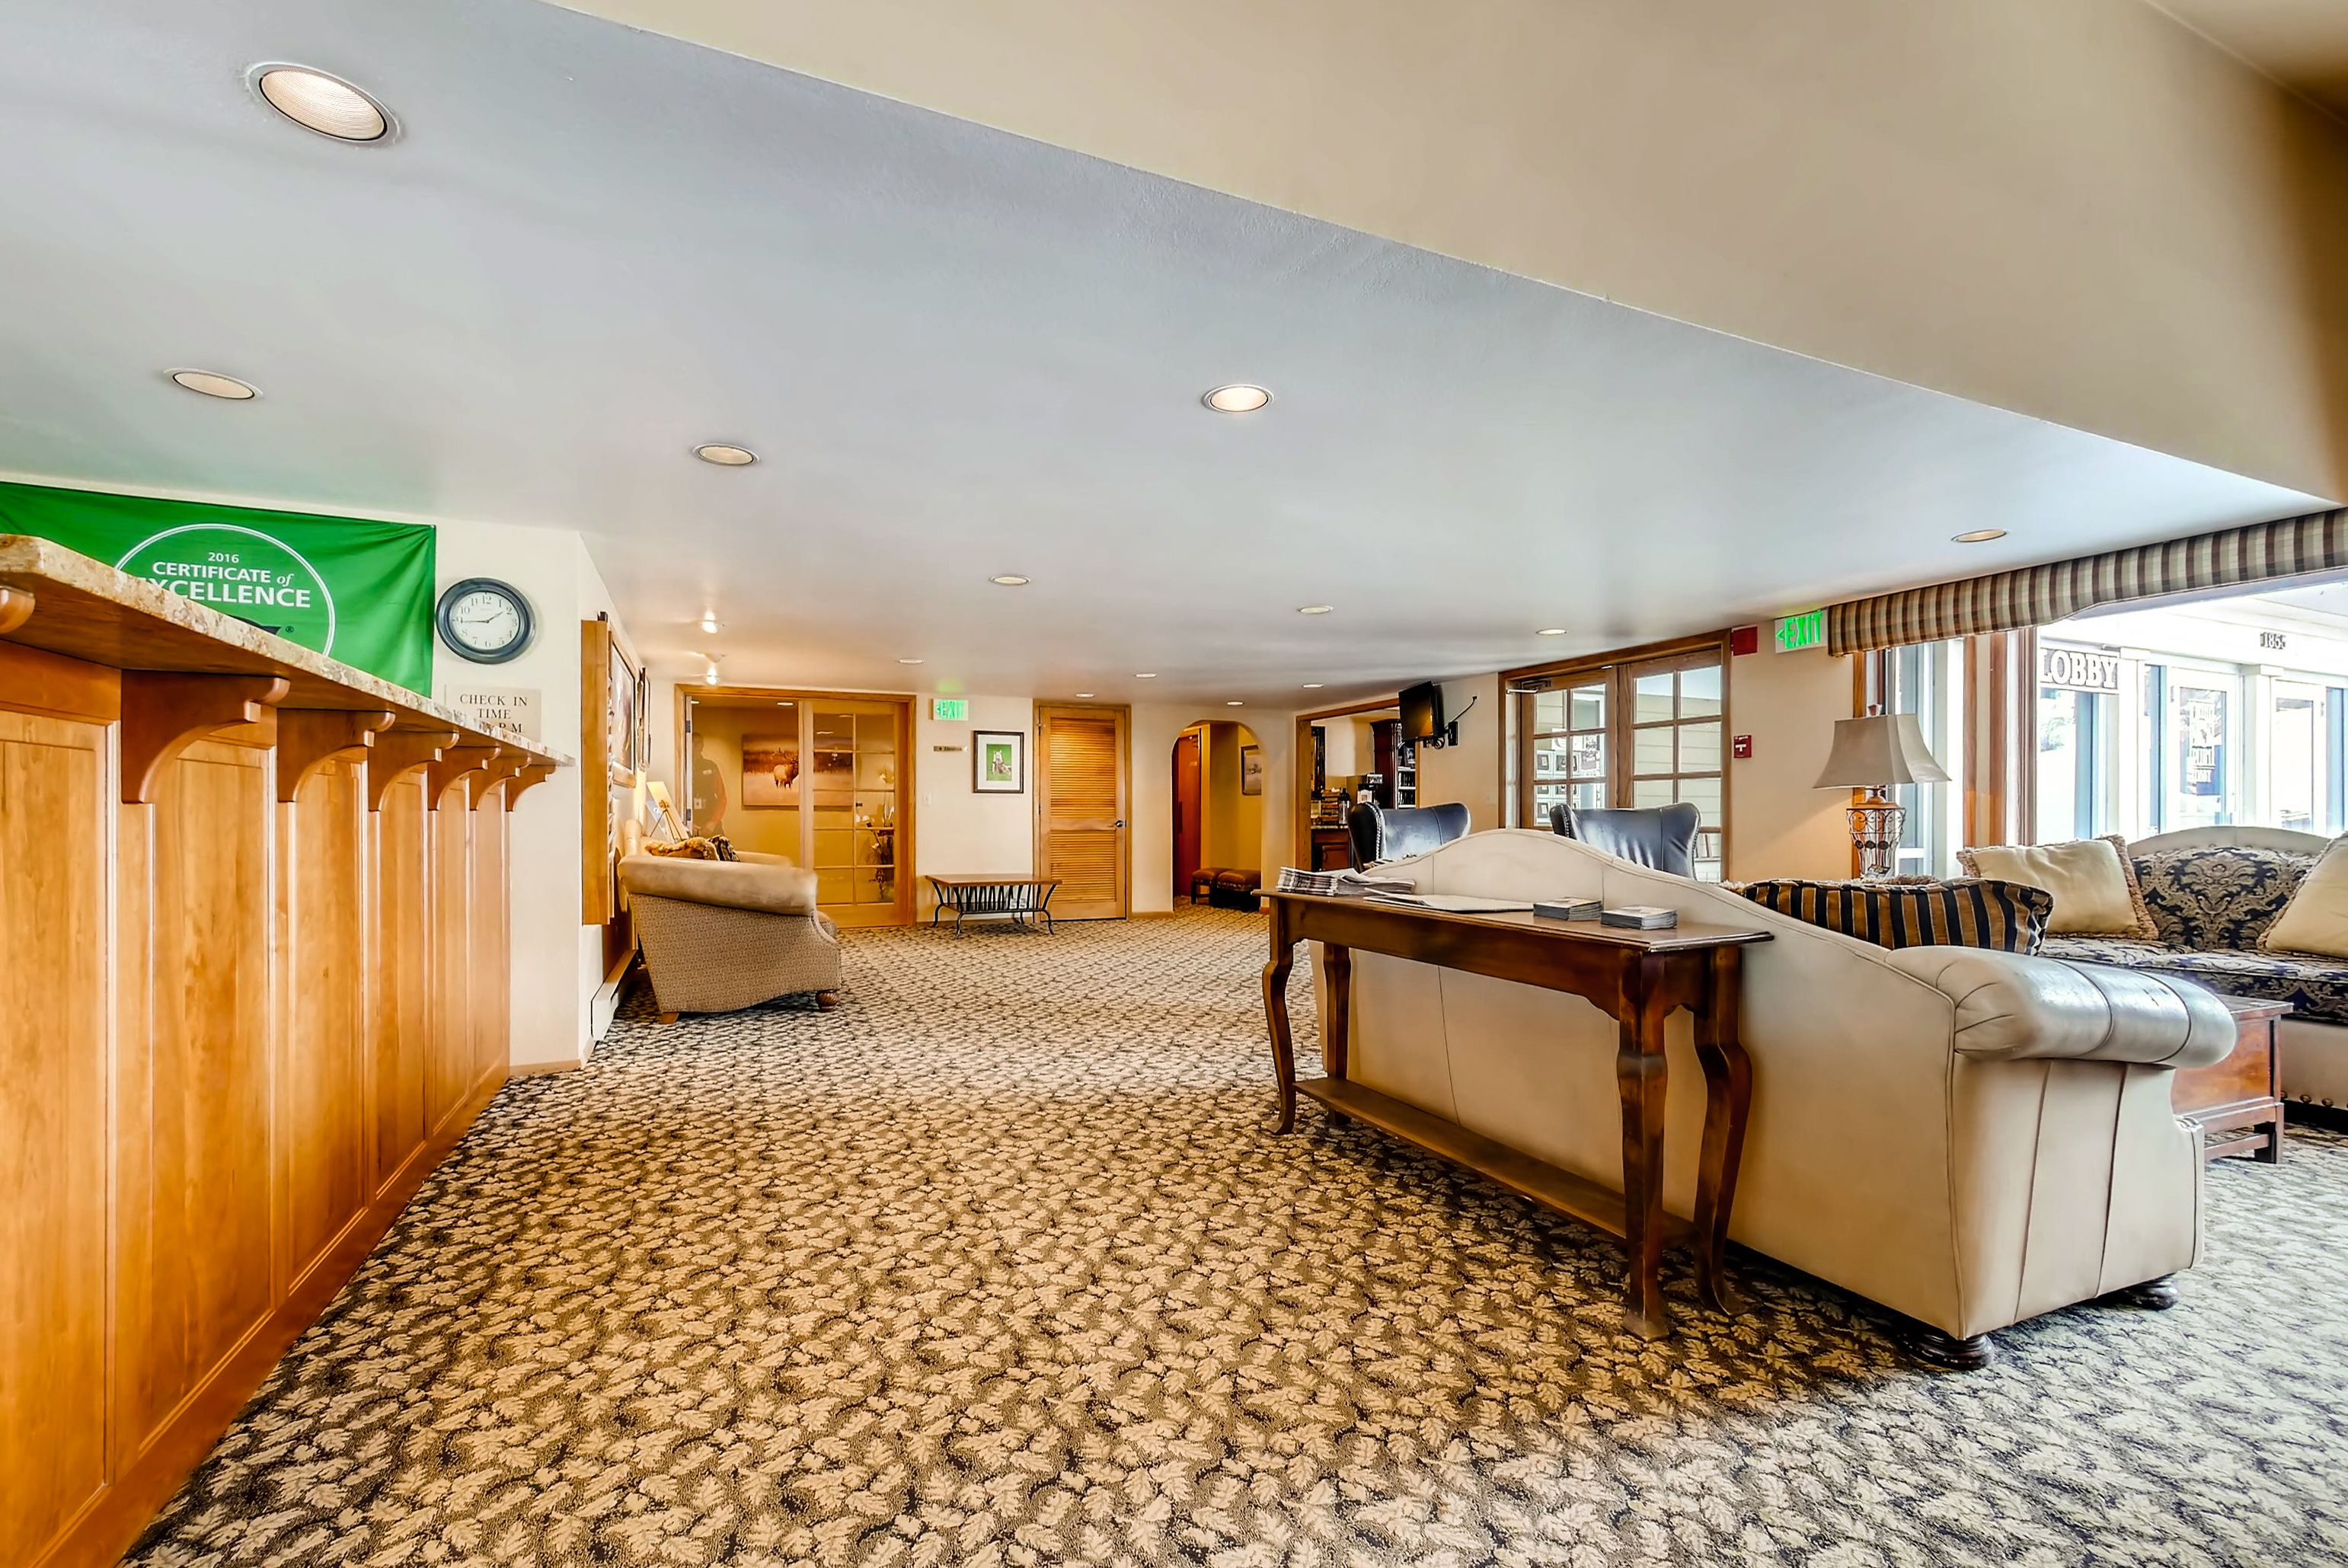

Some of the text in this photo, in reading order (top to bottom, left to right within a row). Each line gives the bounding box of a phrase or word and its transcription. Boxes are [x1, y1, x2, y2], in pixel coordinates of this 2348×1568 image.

[208, 552, 239, 563] 2016
[152, 562, 295, 587] CERTIFICATE of
[138, 577, 311, 608] CELLENCE
[482, 595, 492, 605] 12
[471, 597, 478, 606] 11
[506, 606, 512, 615] 2
[1785, 611, 1823, 649] EXIT
[2261, 632, 2287, 650] 1855
[2040, 649, 2117, 688] LOBBY
[460, 694, 527, 707] CHECK IN
[477, 708, 511, 720] TIME
[940, 699, 964, 719] EXIT
